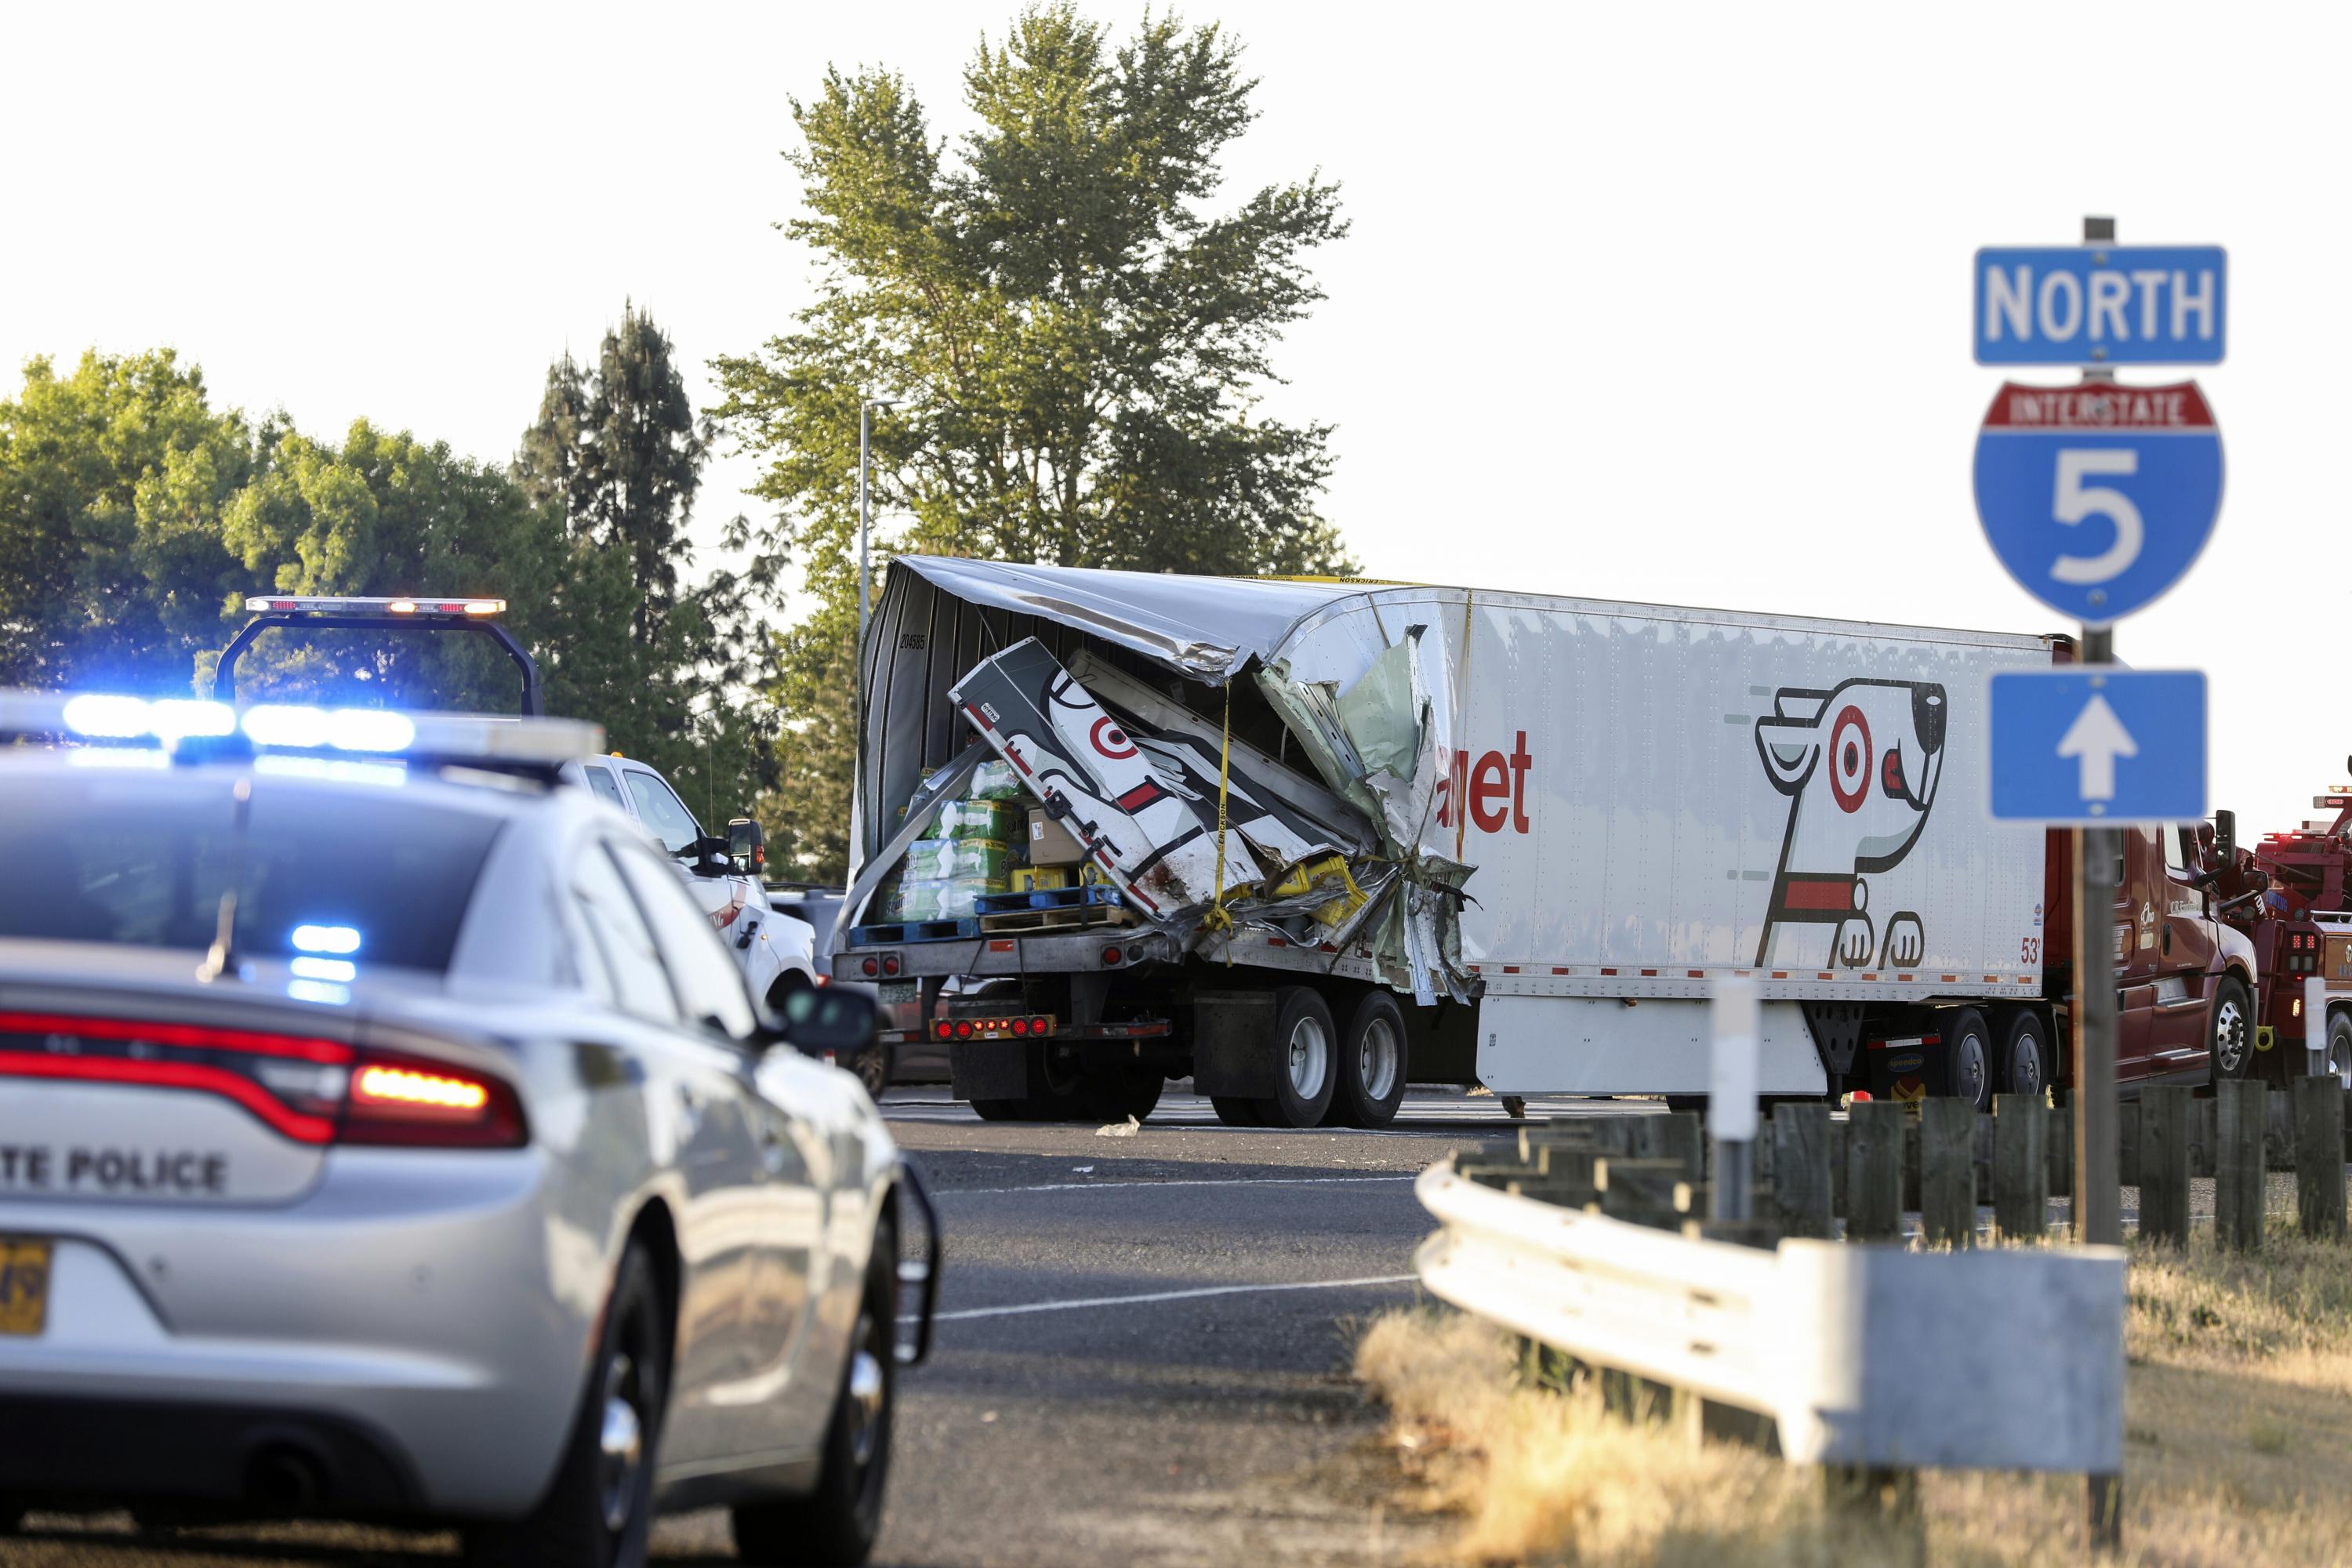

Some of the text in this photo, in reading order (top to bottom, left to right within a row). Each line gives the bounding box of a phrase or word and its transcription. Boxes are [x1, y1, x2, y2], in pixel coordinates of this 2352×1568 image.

[1984, 265, 2216, 343] NORTH
[2009, 394, 2187, 424] INTERSTATE
[2049, 448, 2143, 585] 5
[900, 633, 924, 650] 204585
[67, 1147, 227, 1192] POLICE
